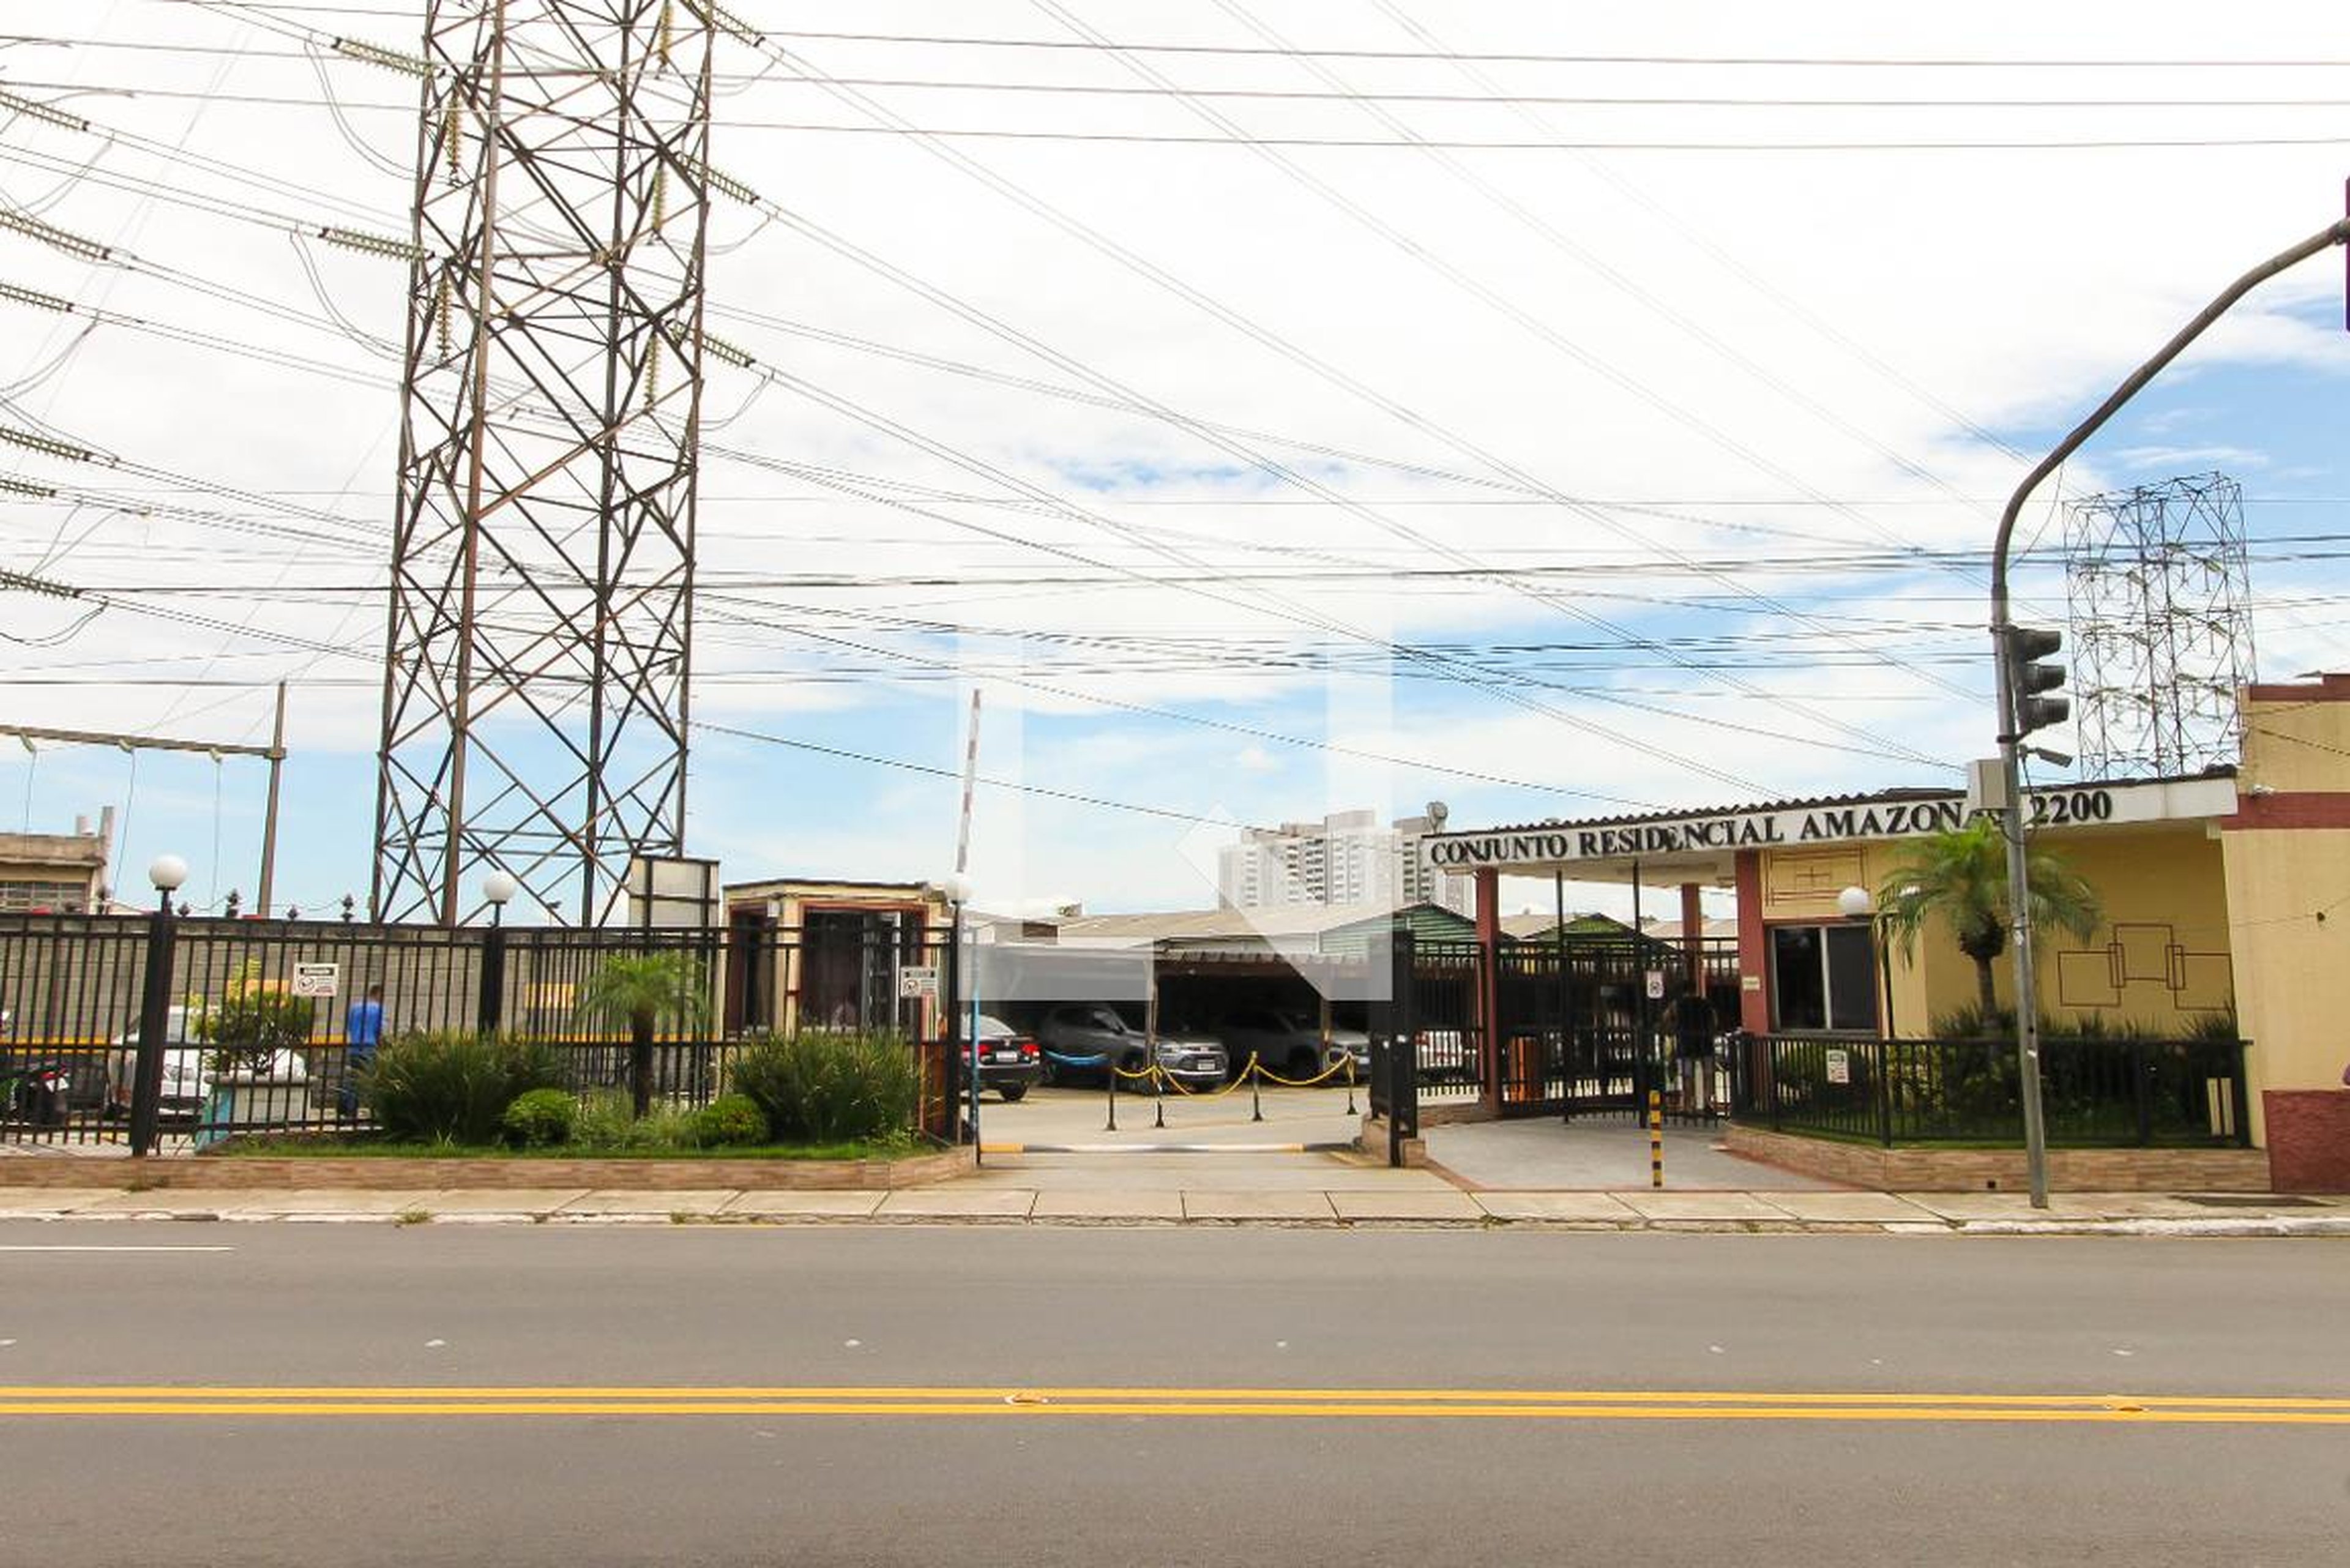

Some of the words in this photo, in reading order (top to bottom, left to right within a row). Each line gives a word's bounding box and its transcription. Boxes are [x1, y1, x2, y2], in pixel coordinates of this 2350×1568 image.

[1430, 834, 1569, 864] CONJUNTO
[1578, 816, 1785, 856] RESIDENCIAL
[1800, 802, 2004, 840] AMAZON
[2029, 790, 2113, 824] 2200
